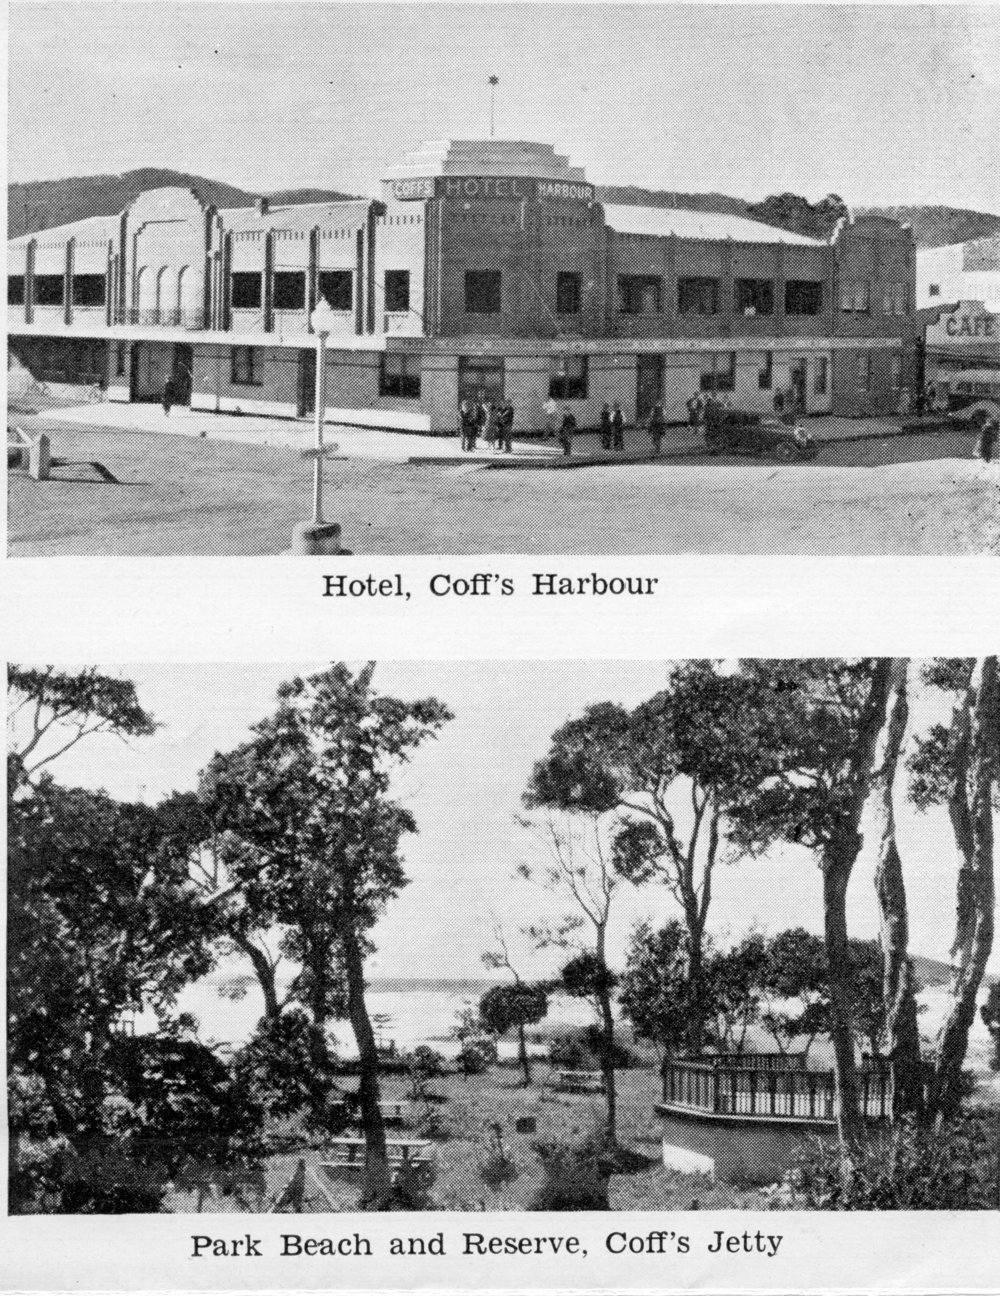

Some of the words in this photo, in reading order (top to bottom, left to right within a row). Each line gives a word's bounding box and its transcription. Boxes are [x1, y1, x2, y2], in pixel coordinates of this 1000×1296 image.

[393, 181, 432, 196] COFFS
[446, 179, 522, 196] HOTEL
[537, 183, 593, 199] HARBOUR
[946, 316, 995, 336] CAFE
